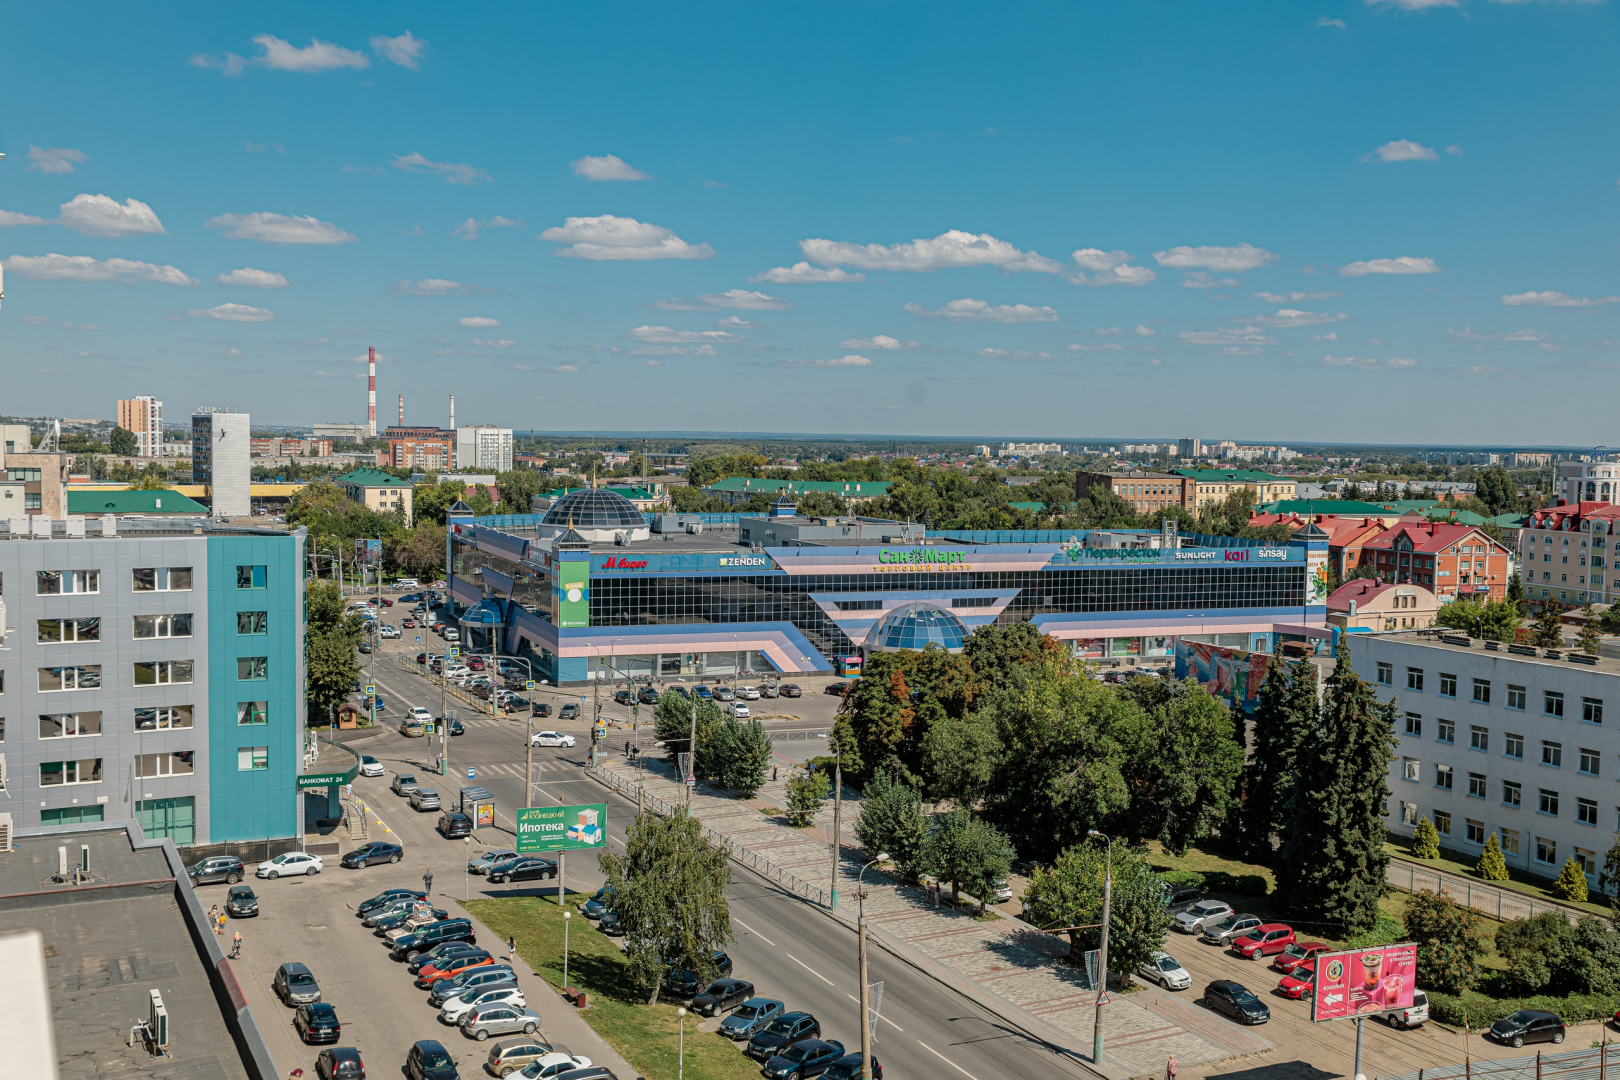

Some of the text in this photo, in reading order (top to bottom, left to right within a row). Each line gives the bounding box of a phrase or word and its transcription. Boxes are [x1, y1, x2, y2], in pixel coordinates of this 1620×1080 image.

[879, 548, 966, 564] Сан Март
[1175, 552, 1216, 560] SUNLIGHT
[1225, 549, 1250, 561] kari
[1258, 548, 1287, 560] sinsay
[728, 558, 765, 566] ZENDEN
[873, 564, 972, 572] ТОРГОВЫЙ ЦЕНТР
[520, 823, 564, 832] Ипотека
